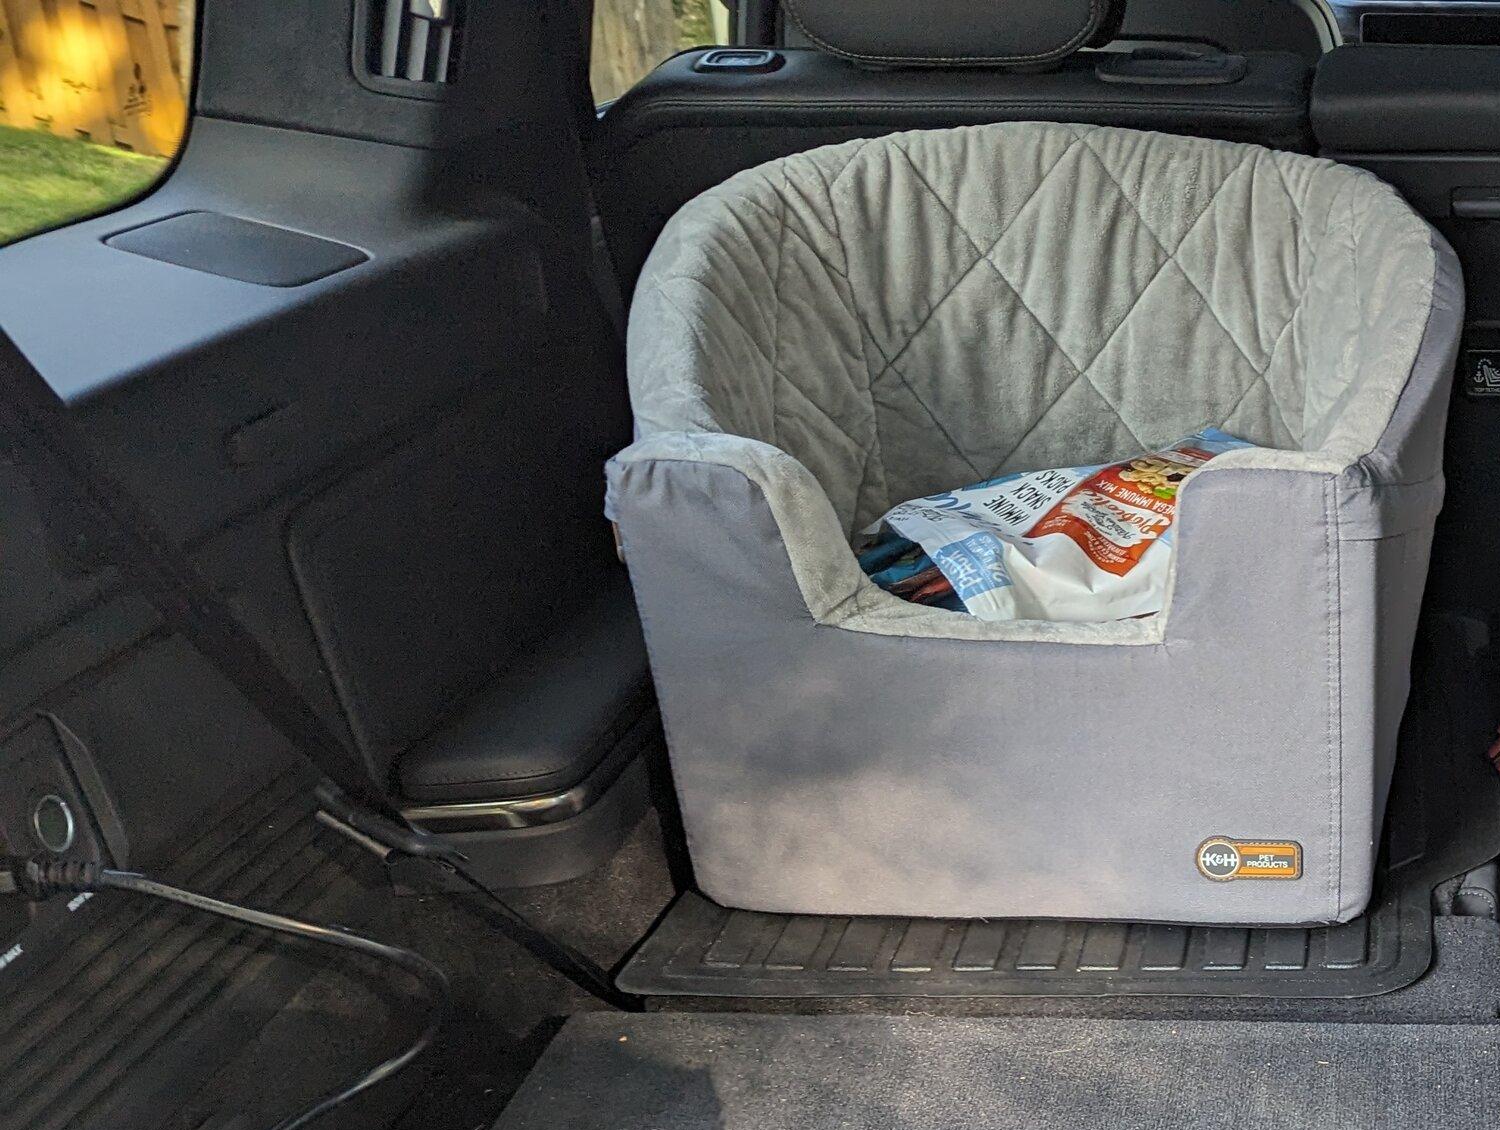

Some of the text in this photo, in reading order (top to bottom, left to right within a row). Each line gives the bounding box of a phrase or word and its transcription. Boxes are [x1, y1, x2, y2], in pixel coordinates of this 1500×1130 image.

[1036, 470, 1076, 493] PACKS
[1010, 482, 1051, 510] SNACK
[1096, 480, 1176, 516] MEGA IMMUNE MIX
[983, 495, 1030, 526] IMMUNE
[1204, 852, 1236, 867] K&H
[1246, 860, 1289, 869] PRODUCTS
